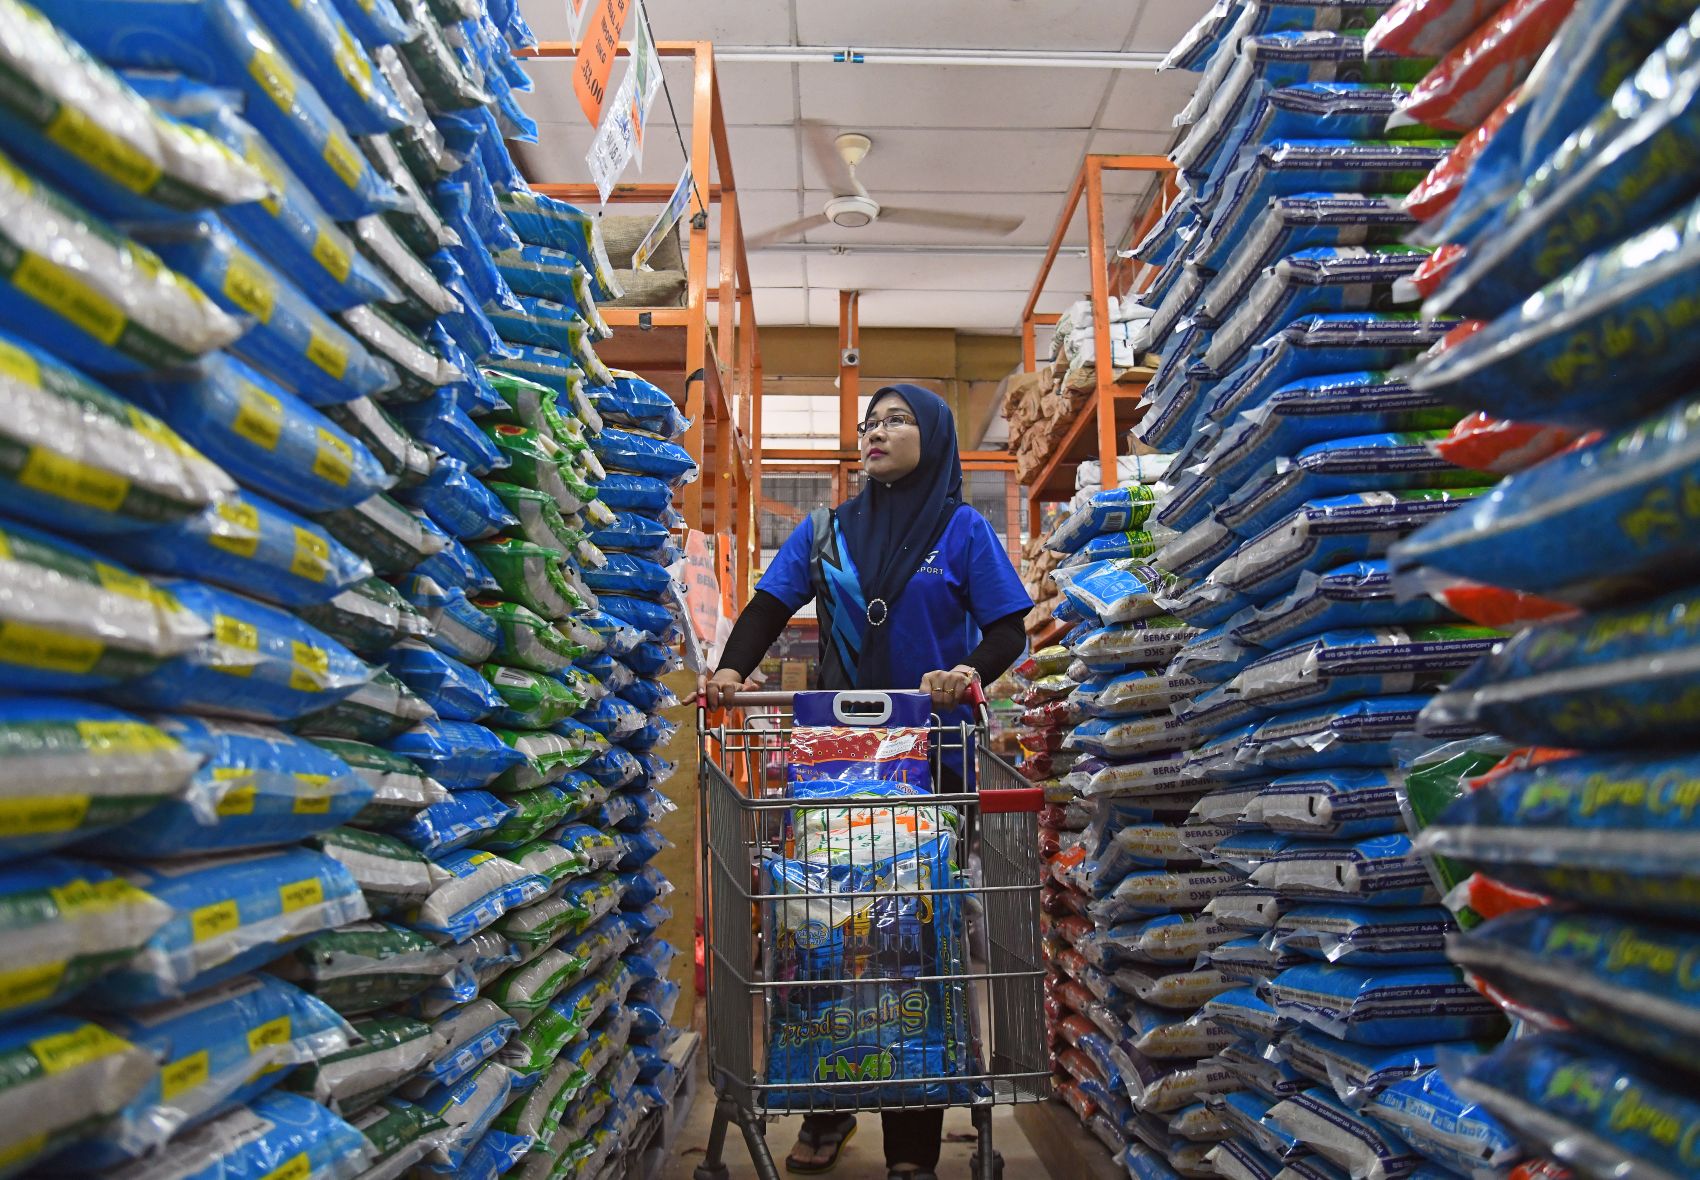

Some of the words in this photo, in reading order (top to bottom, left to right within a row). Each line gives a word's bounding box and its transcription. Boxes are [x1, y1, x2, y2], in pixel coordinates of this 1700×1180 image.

[1143, 632, 1171, 642] BERAS
[1362, 647, 1393, 657] IMPORT
[1394, 646, 1411, 655] AAA
[1435, 643, 1460, 652] SUPER
[1461, 641, 1491, 650] IMPORT
[1168, 678, 1196, 688] BERAS
[1363, 714, 1394, 723] IMPORT
[1395, 713, 1413, 721] AAA
[1153, 766, 1181, 776] BERAS
[1185, 829, 1213, 838] BERAS
[1188, 876, 1217, 885] BERAS
[1389, 925, 1420, 934] IMPORT
[1421, 924, 1438, 932] AAA
[1381, 989, 1413, 998] IMPORT
